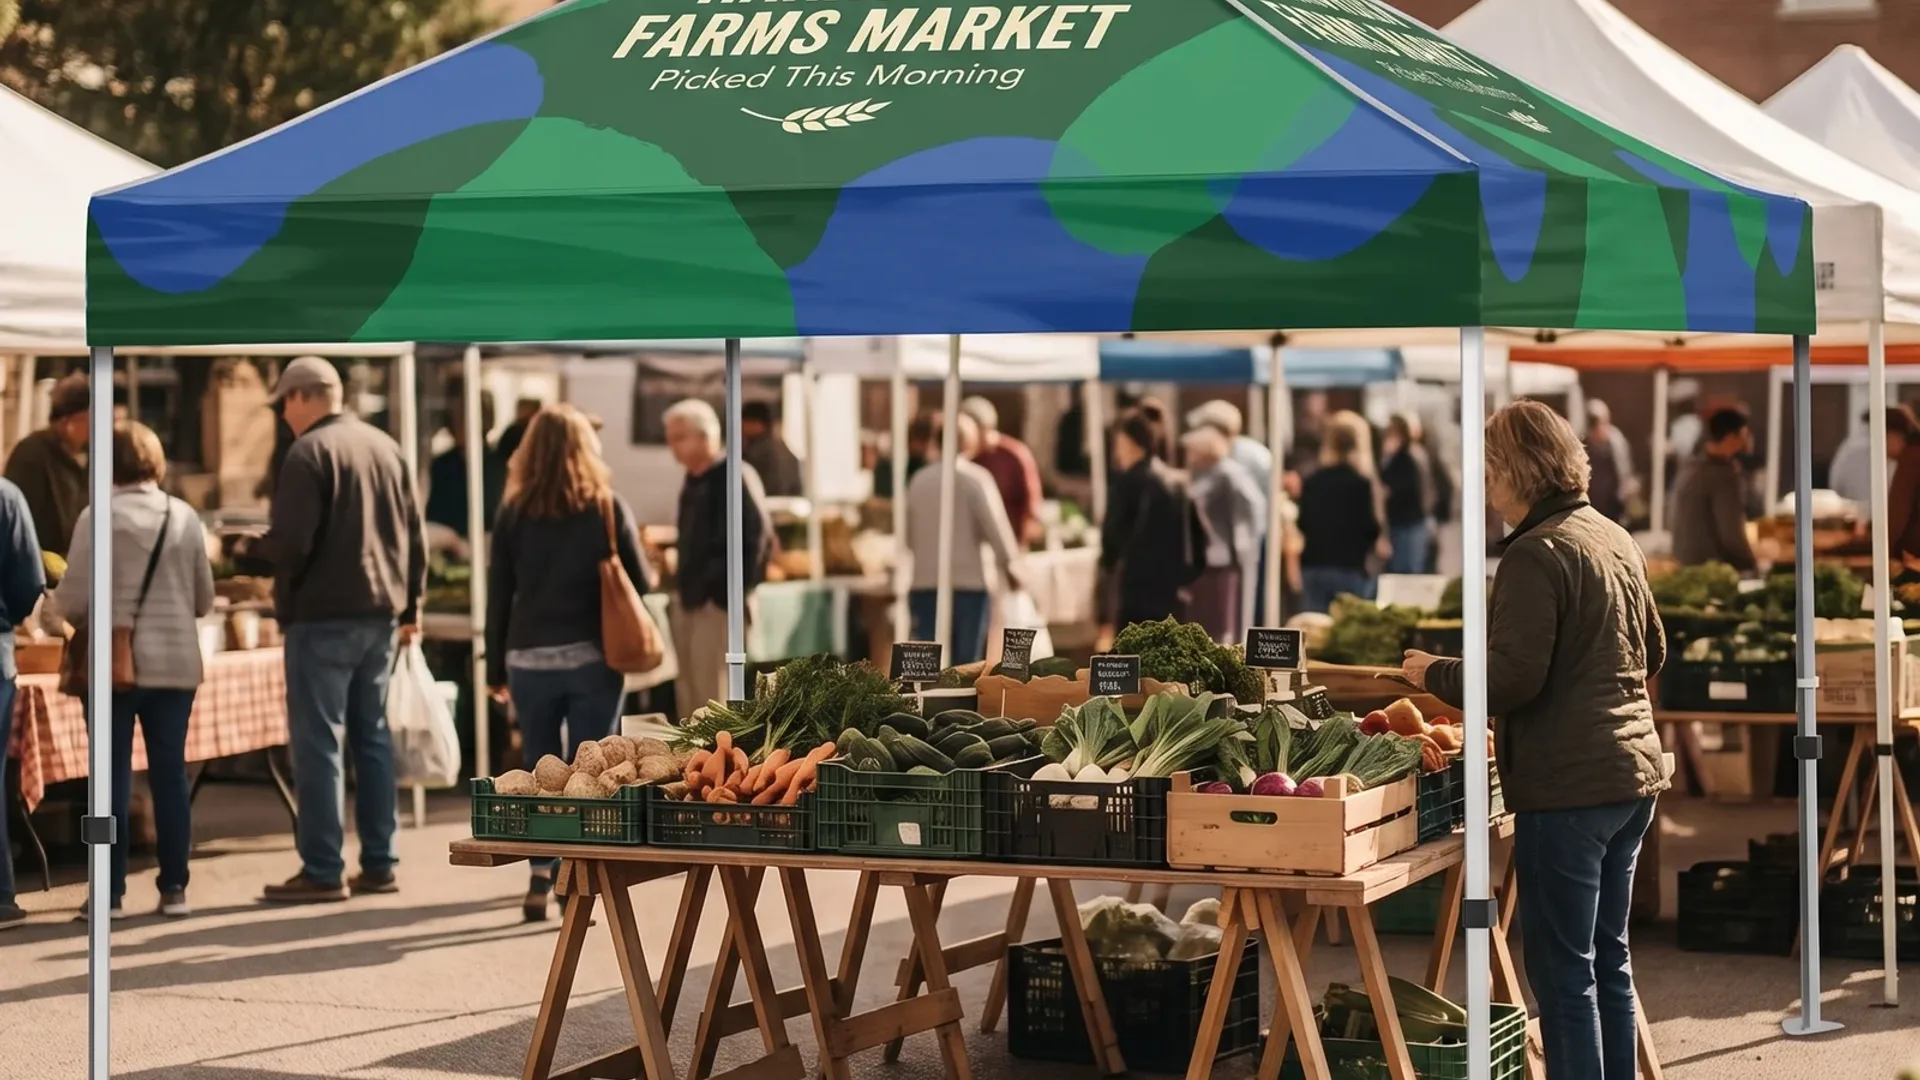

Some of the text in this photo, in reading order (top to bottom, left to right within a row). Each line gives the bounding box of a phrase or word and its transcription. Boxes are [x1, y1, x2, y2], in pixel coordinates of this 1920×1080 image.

[612, 5, 1131, 58] FARMS MARKET
[649, 64, 1026, 91] Picked This Morning
